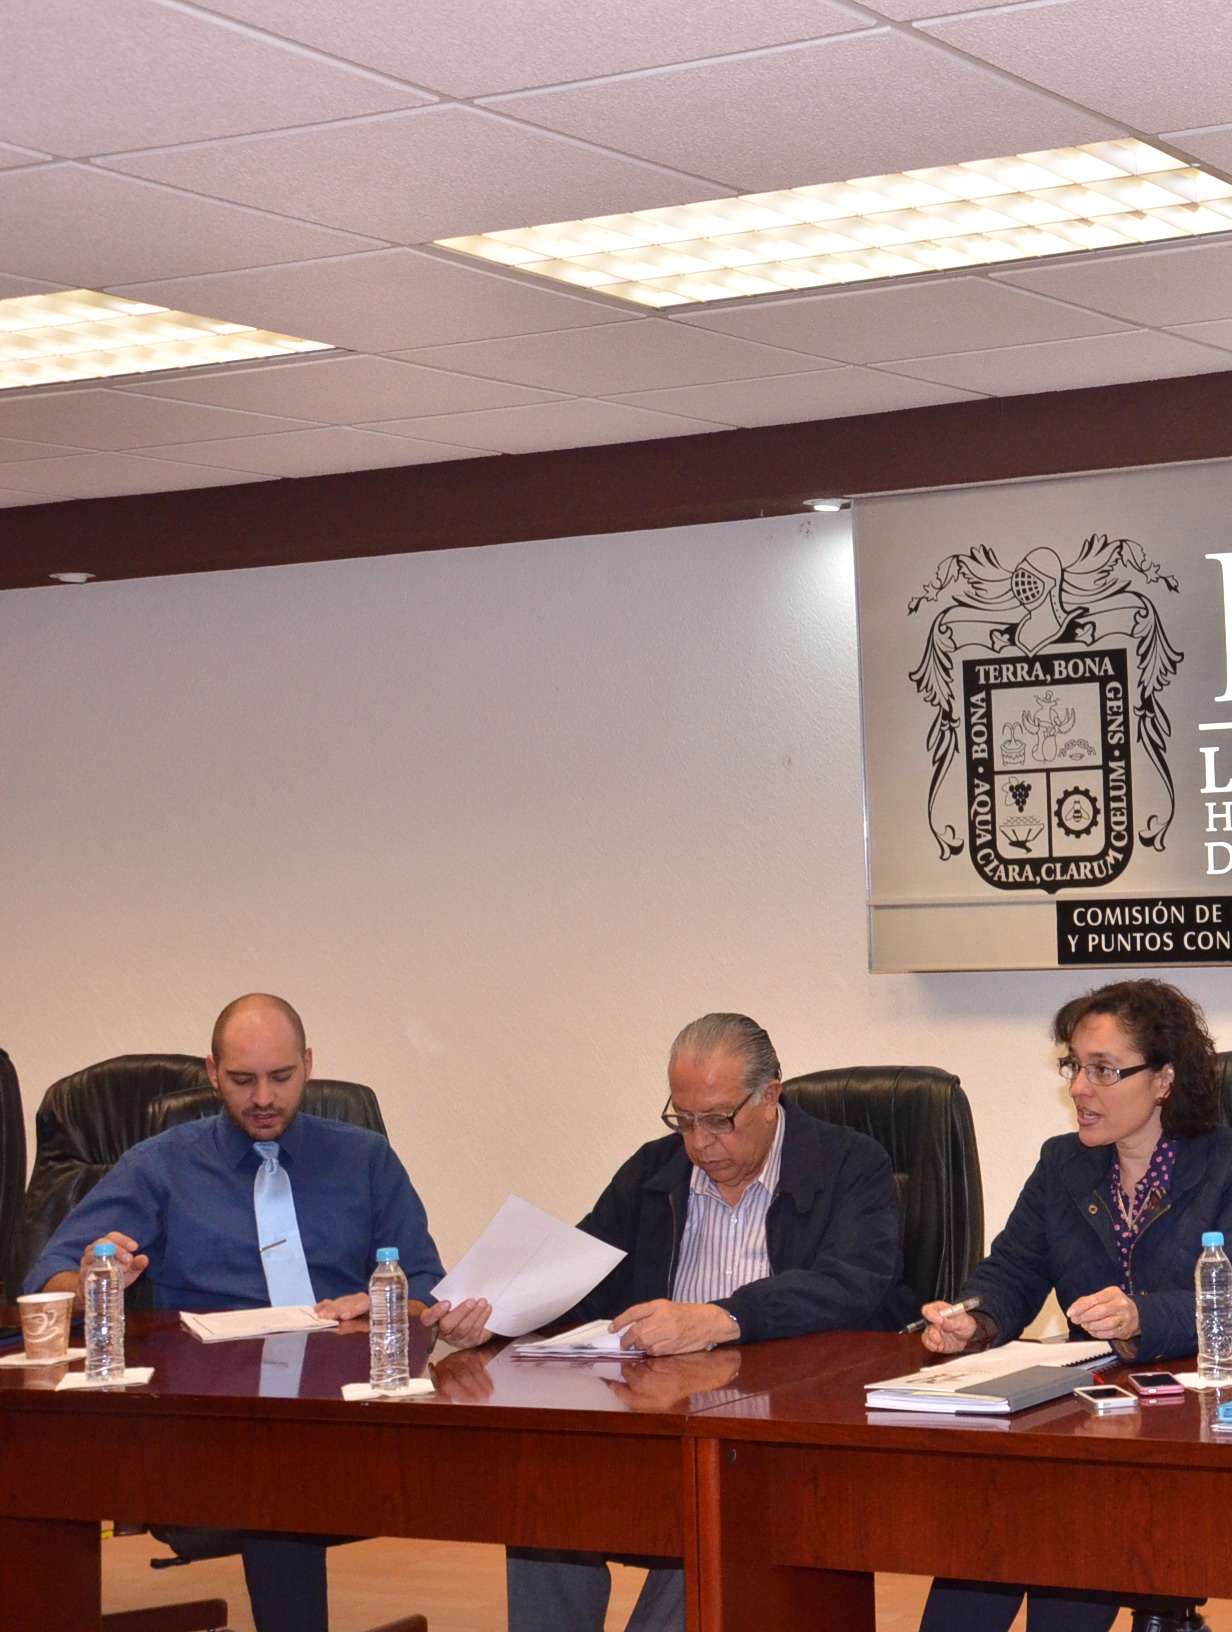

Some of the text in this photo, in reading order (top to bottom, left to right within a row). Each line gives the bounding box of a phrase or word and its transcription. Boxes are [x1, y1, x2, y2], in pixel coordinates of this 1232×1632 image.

[970, 656, 1126, 760] BONA TERRA, BONA GENS
[970, 778, 992, 847] AQUA
[976, 847, 1041, 885] CLARA,
[1040, 847, 1125, 881] CLARUM
[1072, 901, 1185, 927] COMISIÓN
[1195, 904, 1222, 924] DE
[1067, 934, 1079, 953] Y
[1088, 931, 1174, 953] PUNTOS
